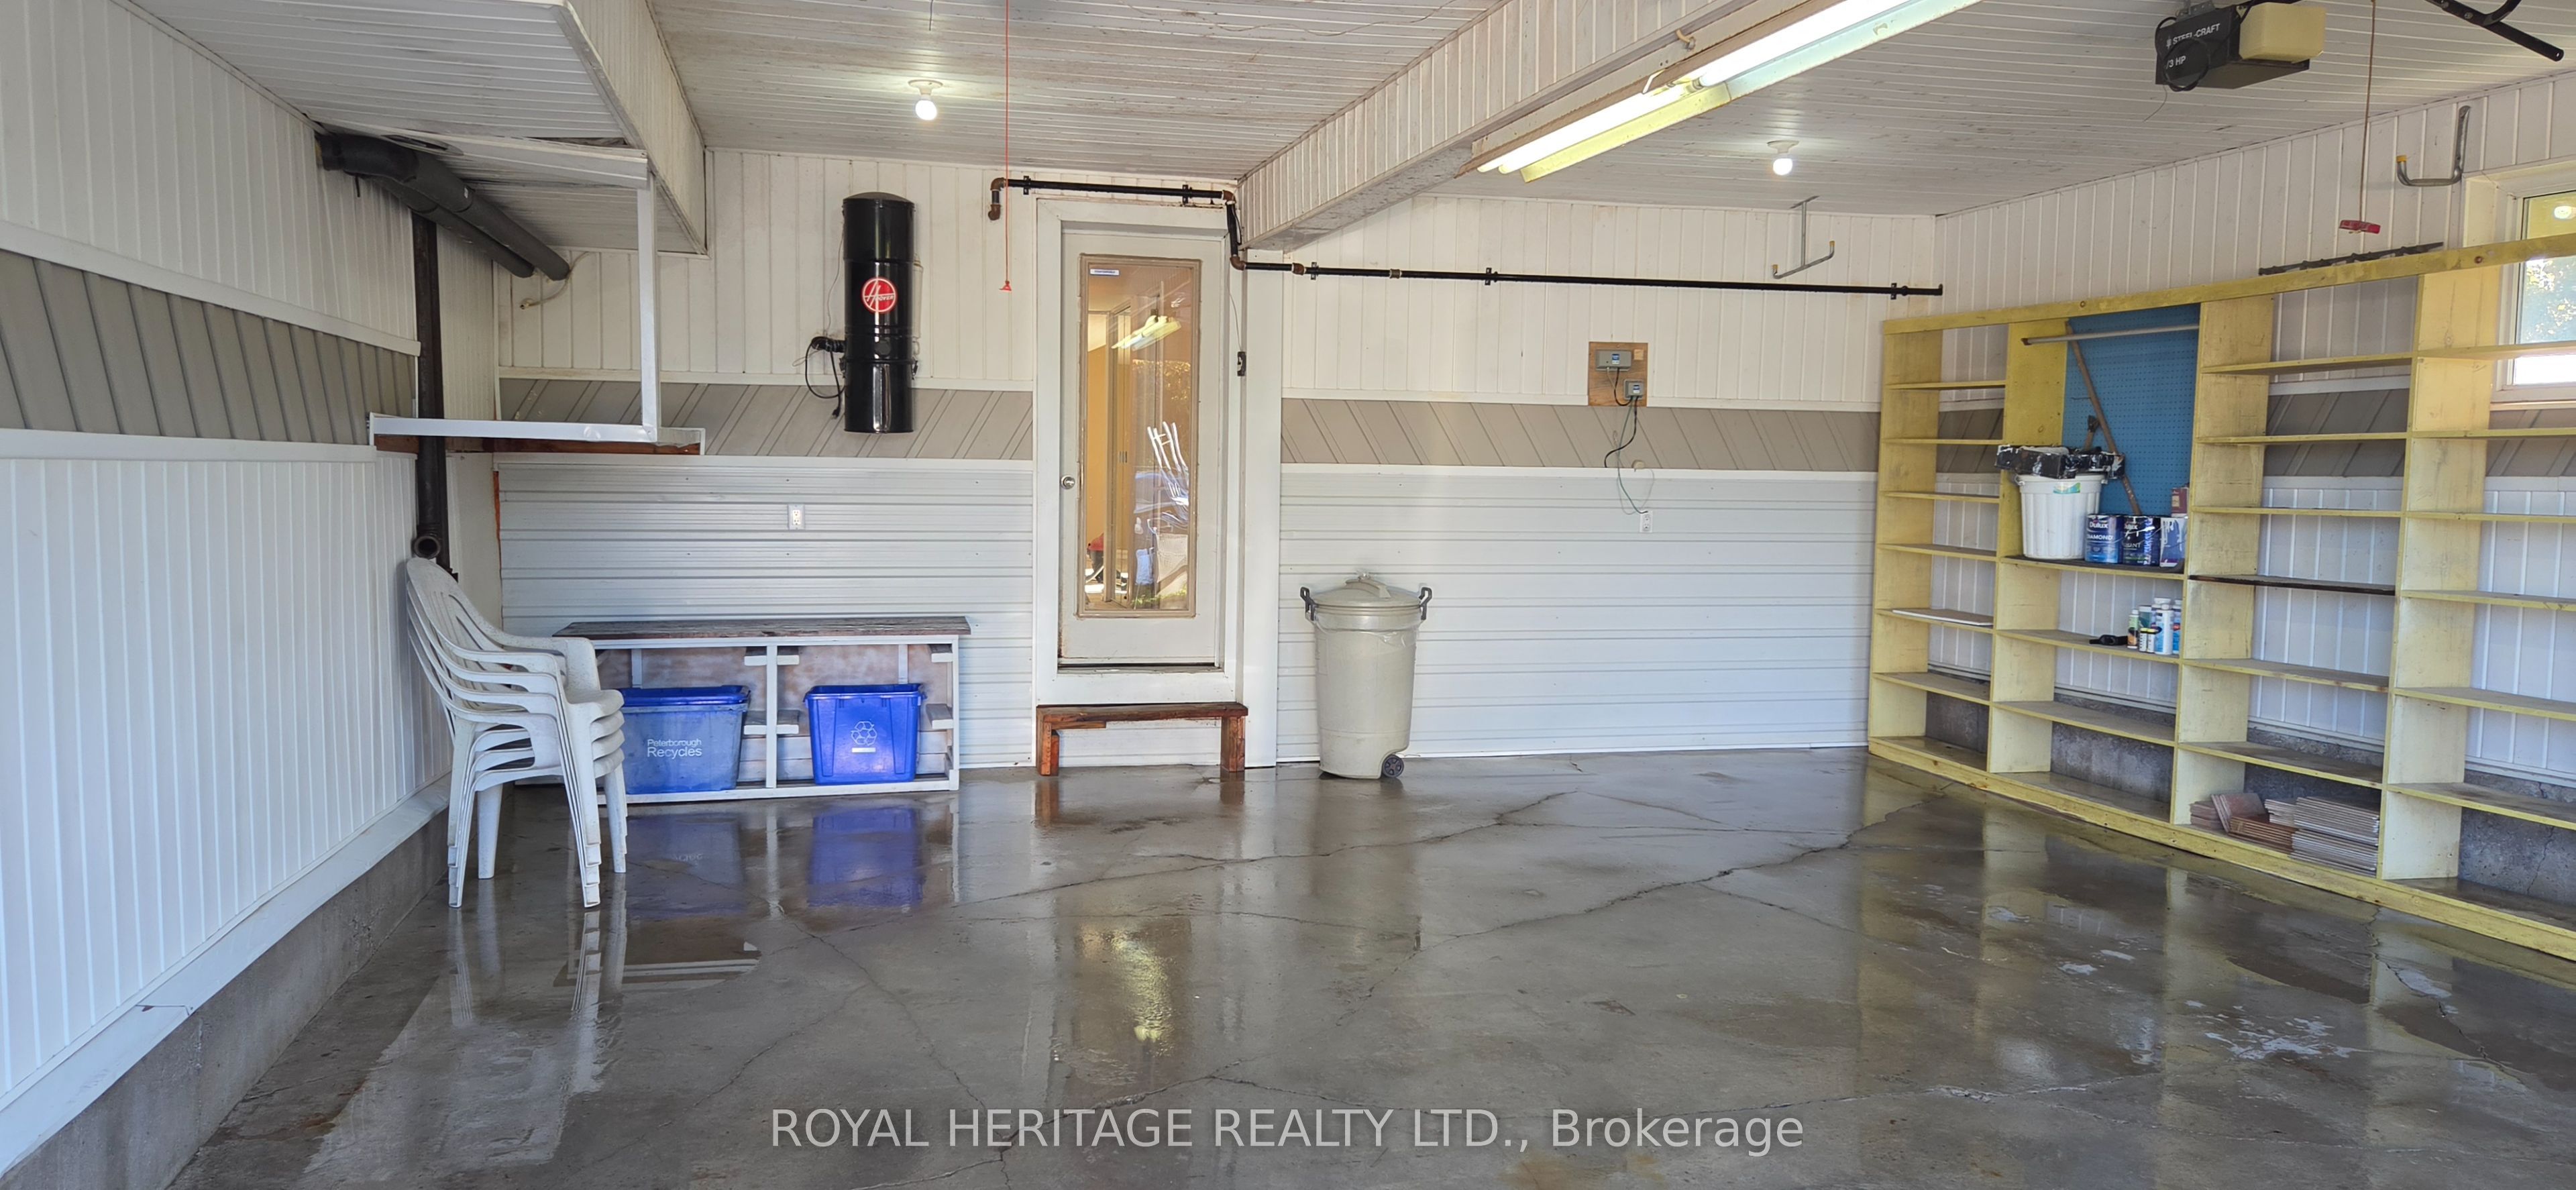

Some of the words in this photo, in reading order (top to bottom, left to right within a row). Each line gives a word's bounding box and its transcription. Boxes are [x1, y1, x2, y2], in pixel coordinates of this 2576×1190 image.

[2176, 56, 2186, 66] HP
[647, 739, 702, 747] Peterborough
[647, 747, 702, 759] Recycles
